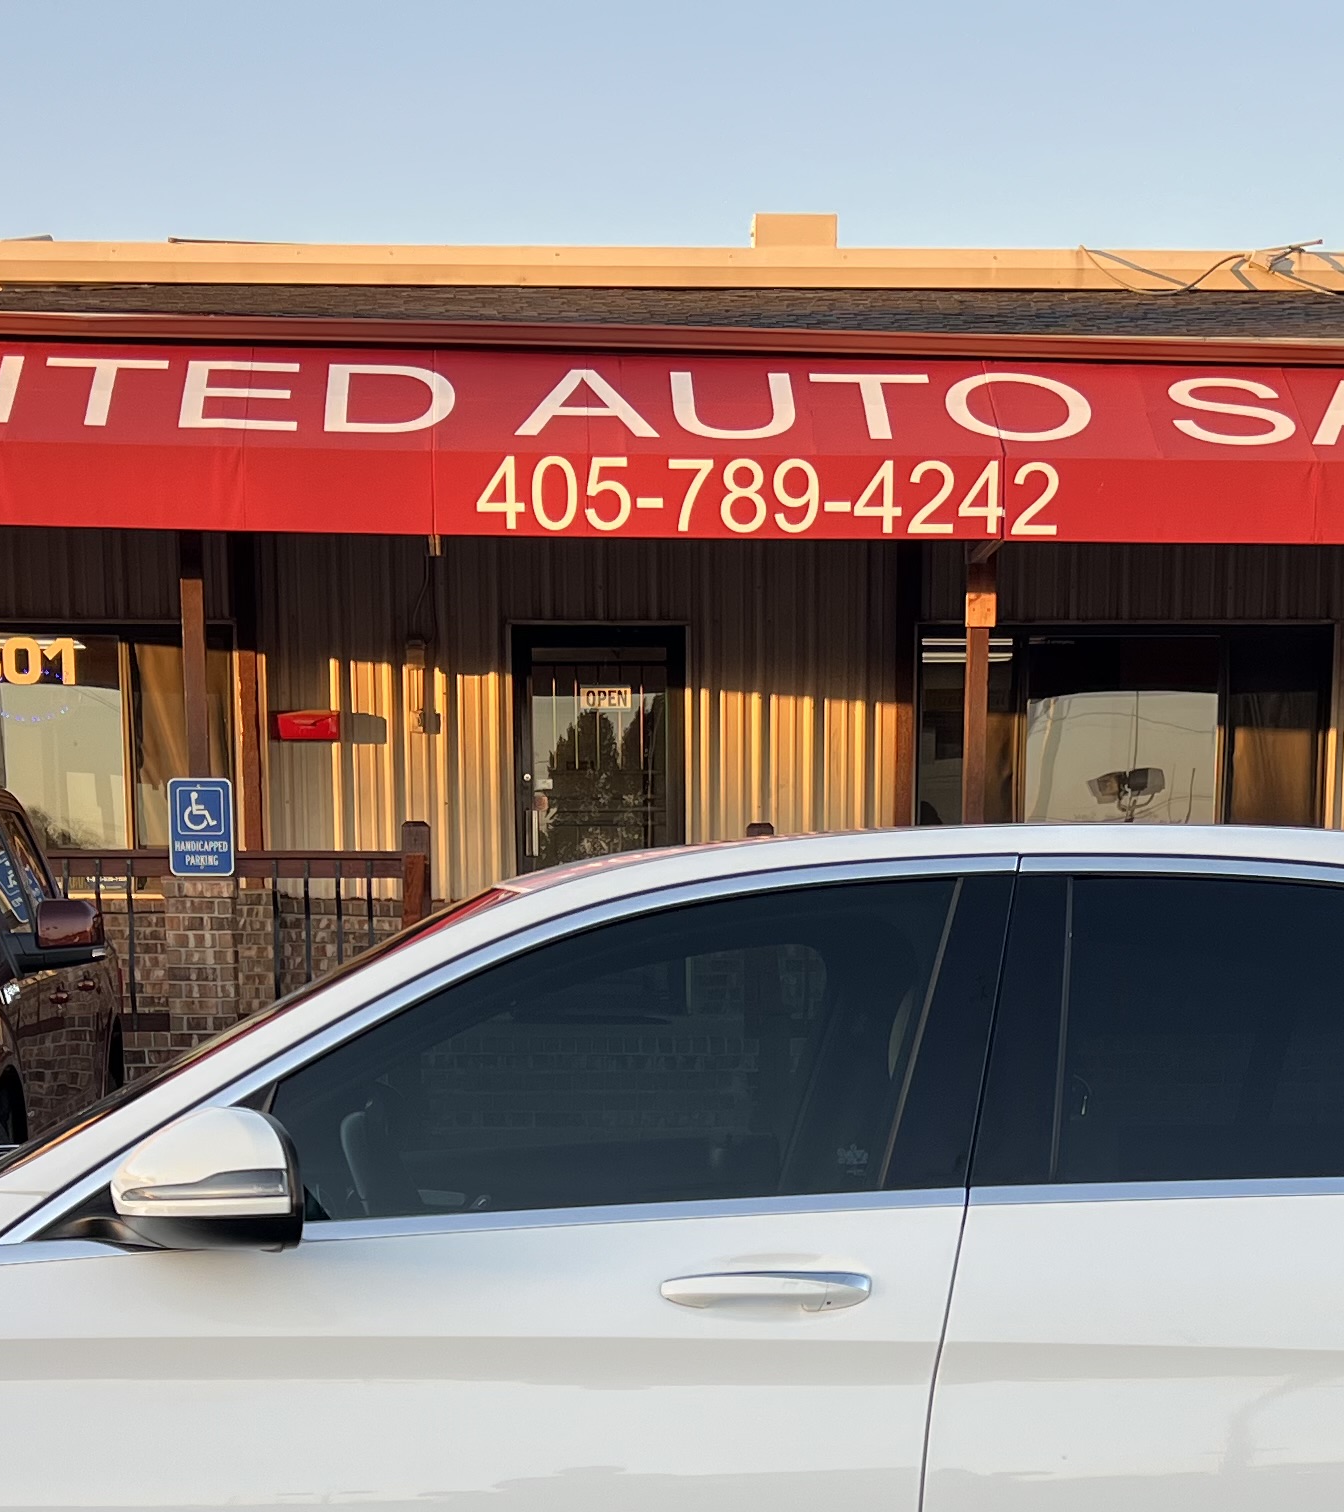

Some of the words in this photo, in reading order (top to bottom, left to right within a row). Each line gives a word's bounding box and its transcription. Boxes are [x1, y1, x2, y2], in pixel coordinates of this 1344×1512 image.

[514, 367, 1092, 442] AUTO
[476, 454, 1061, 535] 405-789-4242
[586, 690, 627, 707] OPEN
[174, 840, 229, 852] HANDICAPPED
[185, 854, 219, 866] PARKING
